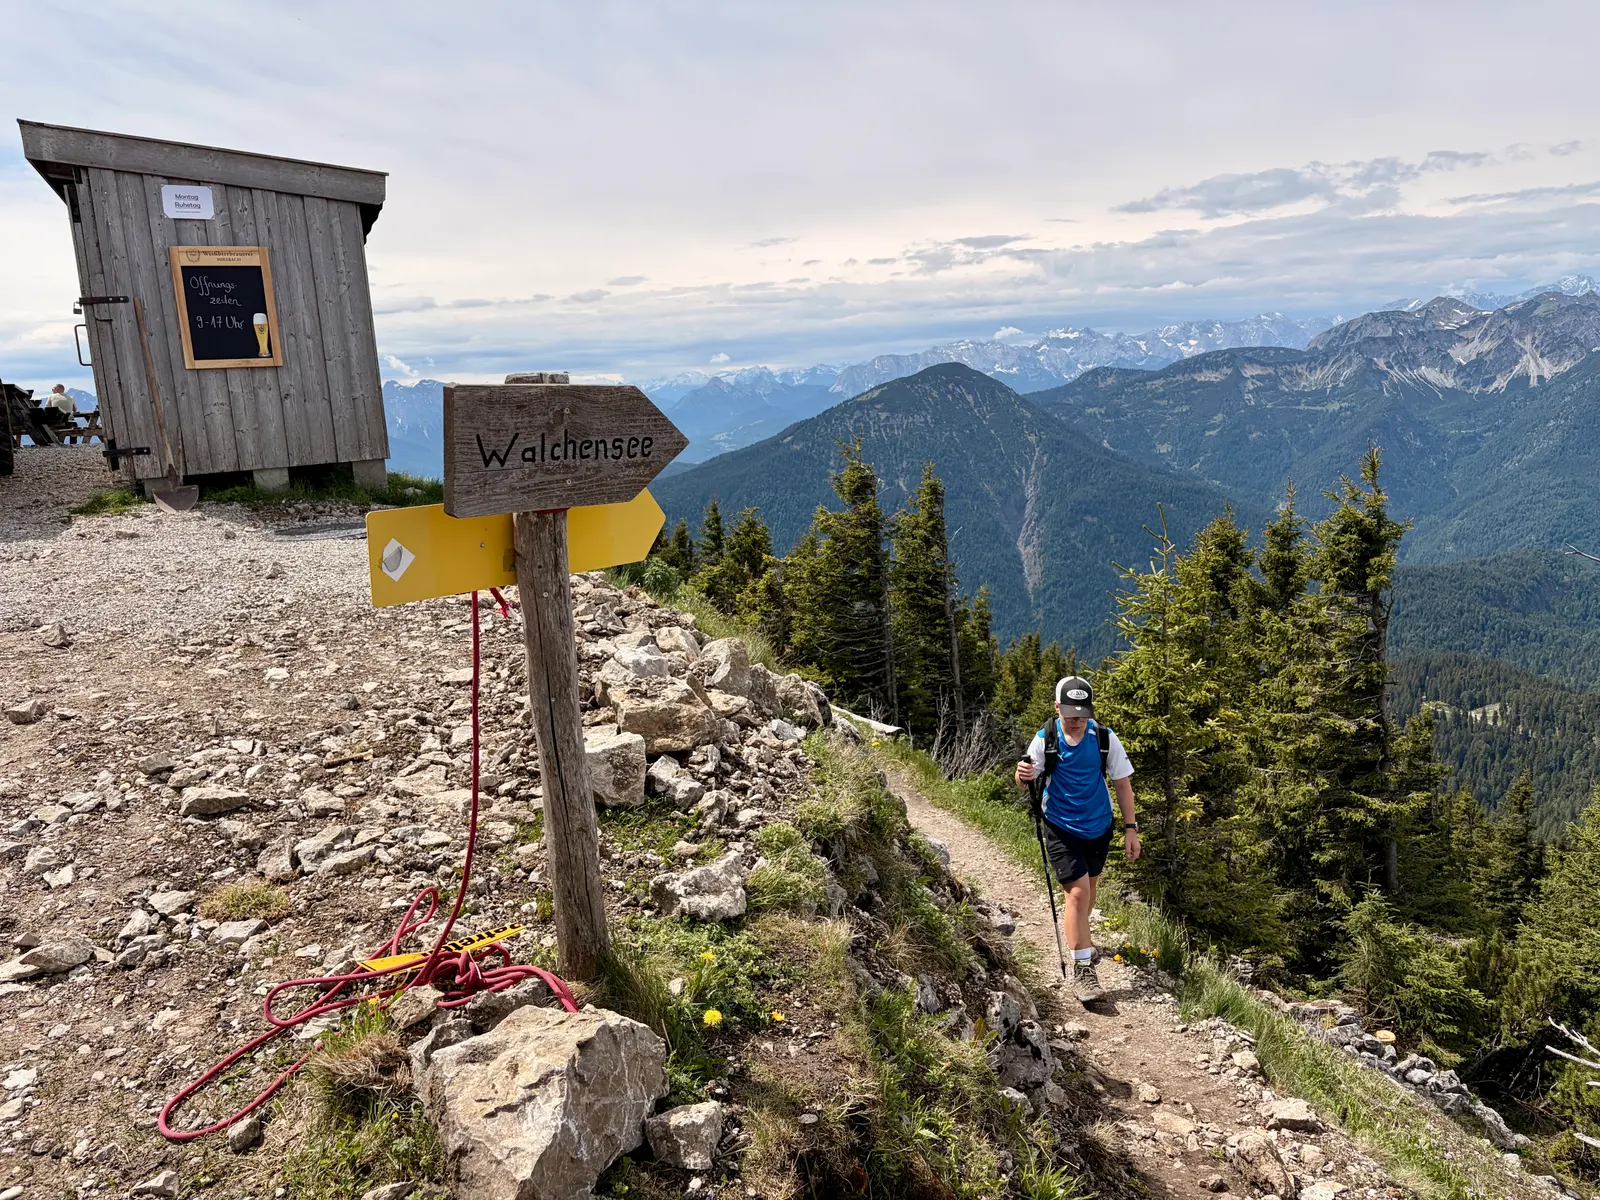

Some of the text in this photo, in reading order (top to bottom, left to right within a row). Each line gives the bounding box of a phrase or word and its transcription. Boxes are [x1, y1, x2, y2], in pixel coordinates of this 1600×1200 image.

[174, 193, 199, 201] Montag
[225, 315, 245, 330] Uhr
[476, 429, 654, 467] Walchensee
